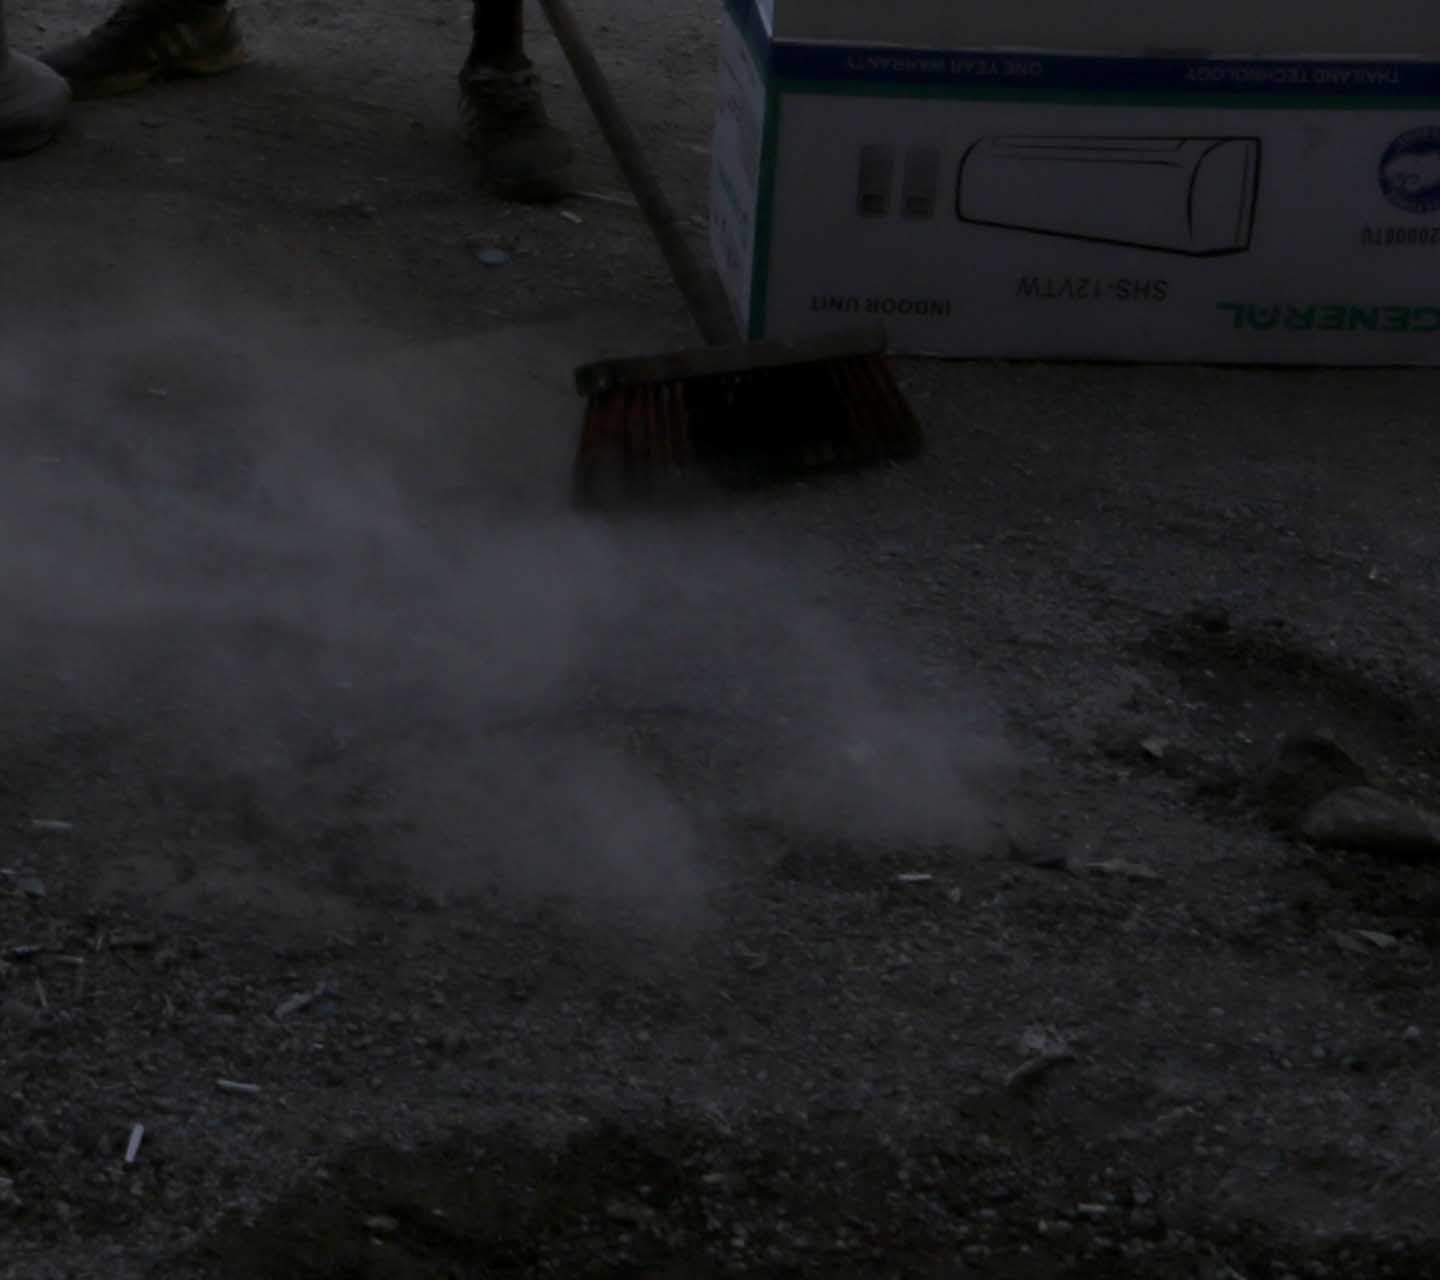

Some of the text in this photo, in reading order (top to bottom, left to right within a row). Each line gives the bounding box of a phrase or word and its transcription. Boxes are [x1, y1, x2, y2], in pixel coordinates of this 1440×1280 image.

[1002, 58, 1044, 76] ONE
[1311, 67, 1402, 86] THAILAND
[1015, 273, 1169, 304] SHS-12VTW
[810, 293, 952, 318] INDOOR UNIT
